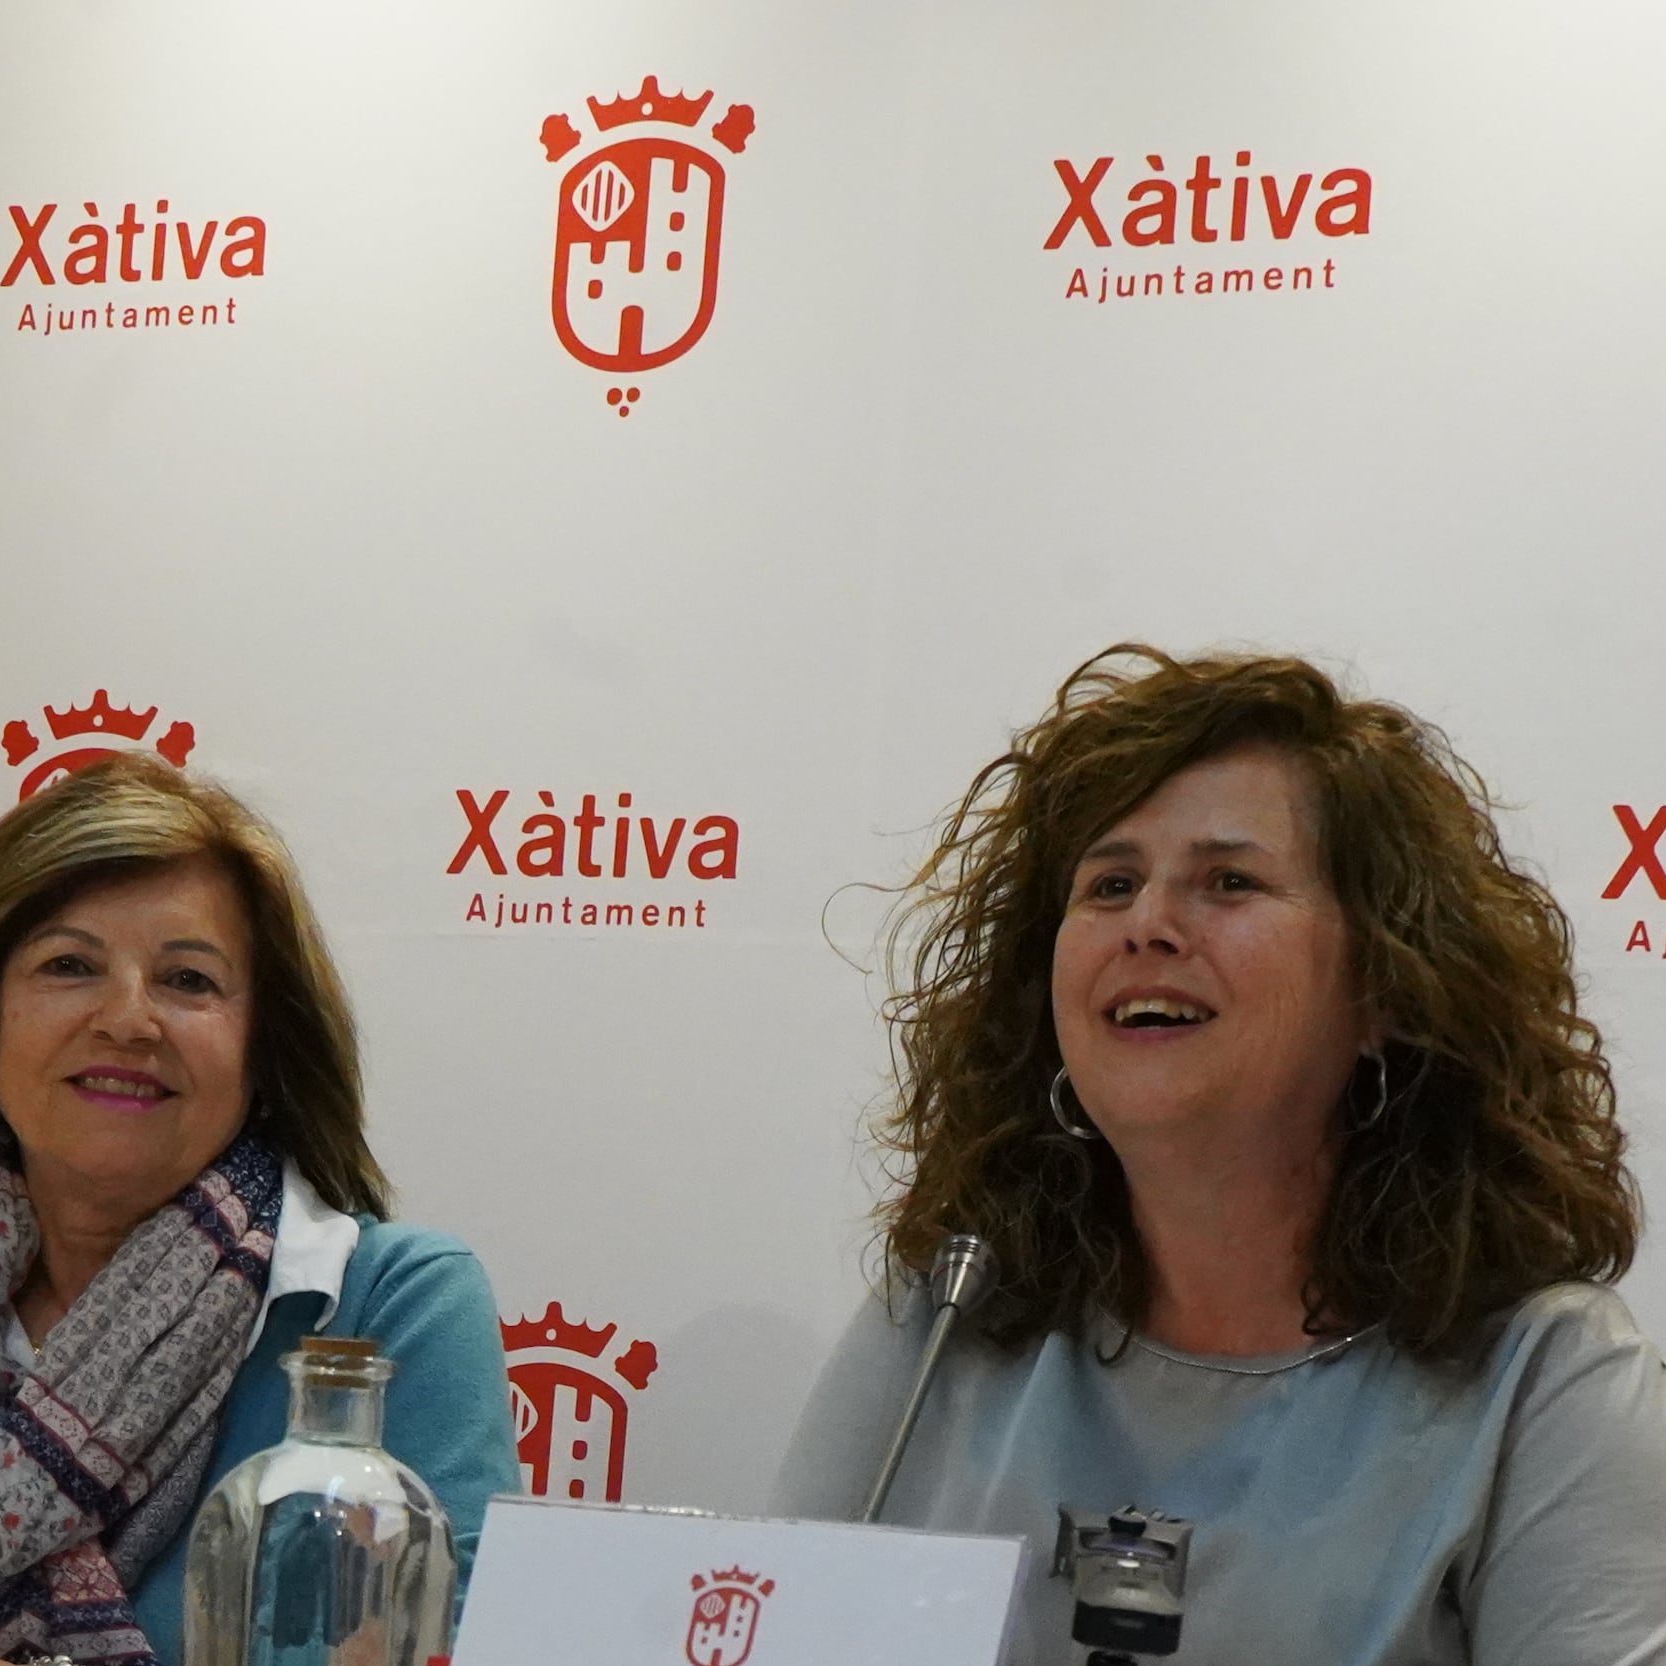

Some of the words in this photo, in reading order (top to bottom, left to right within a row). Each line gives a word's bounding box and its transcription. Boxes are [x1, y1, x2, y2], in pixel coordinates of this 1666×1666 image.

[1043, 150, 1372, 250] Xàtiva
[0, 199, 266, 287] Xàtiva
[1065, 259, 1336, 303] Ajuntament
[17, 297, 237, 335] Ajuntament
[446, 790, 739, 880] Xàtiva
[466, 893, 706, 928] Ajuntament
